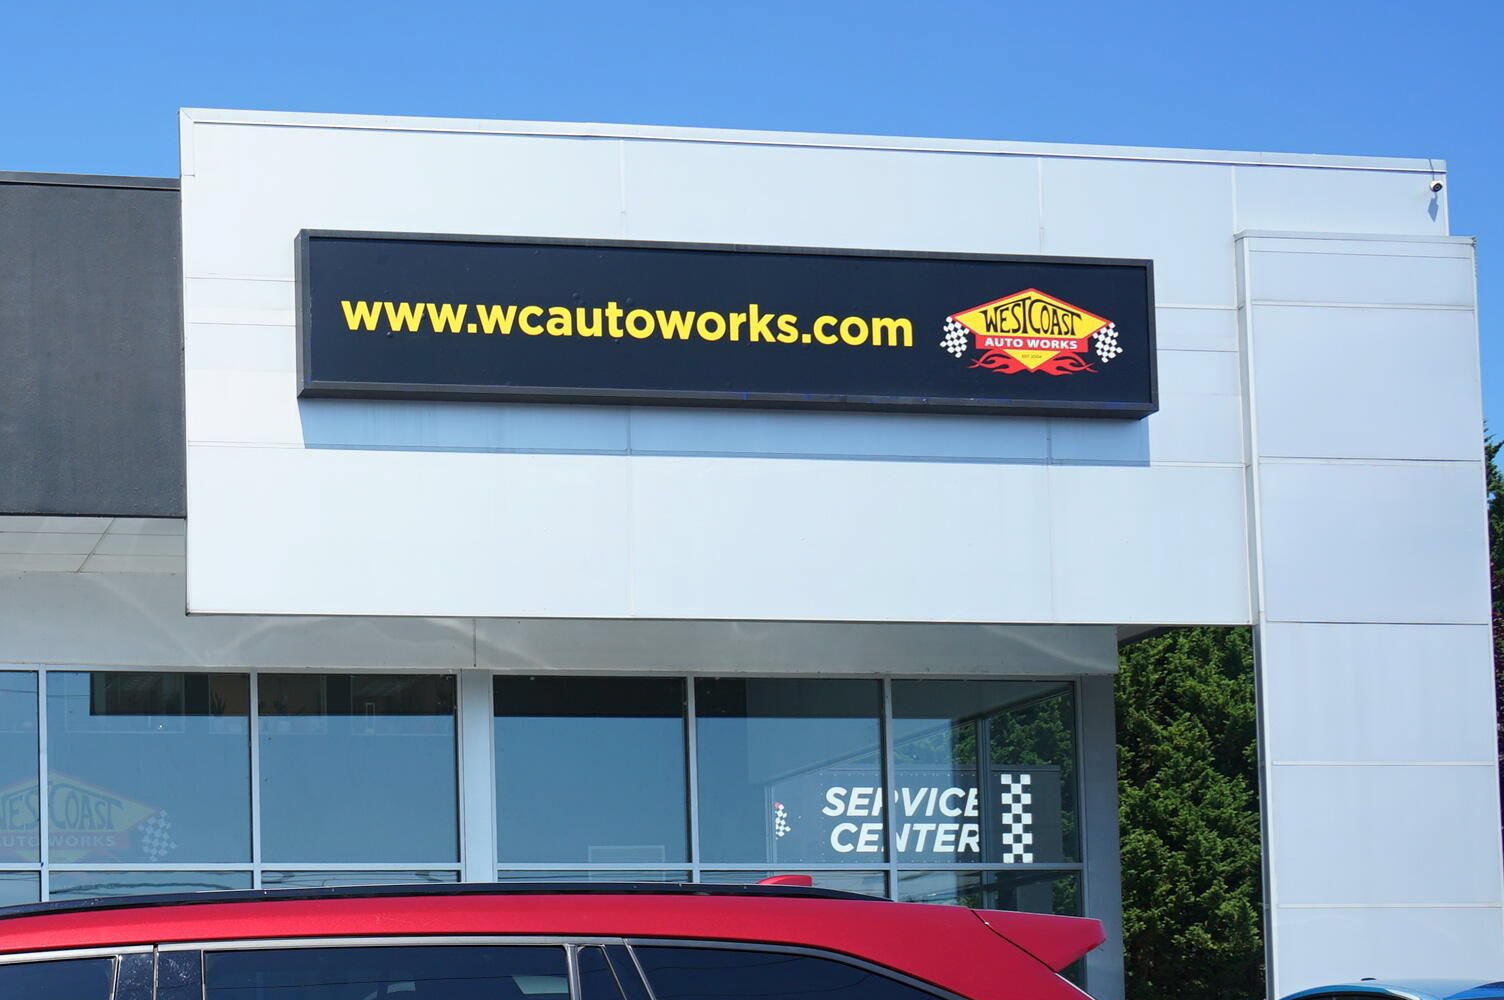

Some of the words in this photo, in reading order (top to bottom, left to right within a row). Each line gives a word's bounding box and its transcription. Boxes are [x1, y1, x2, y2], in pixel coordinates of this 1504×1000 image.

[341, 299, 913, 347] www.wcautoworks.com
[985, 337, 1024, 348] AUTO
[1027, 338, 1078, 349] WORKS
